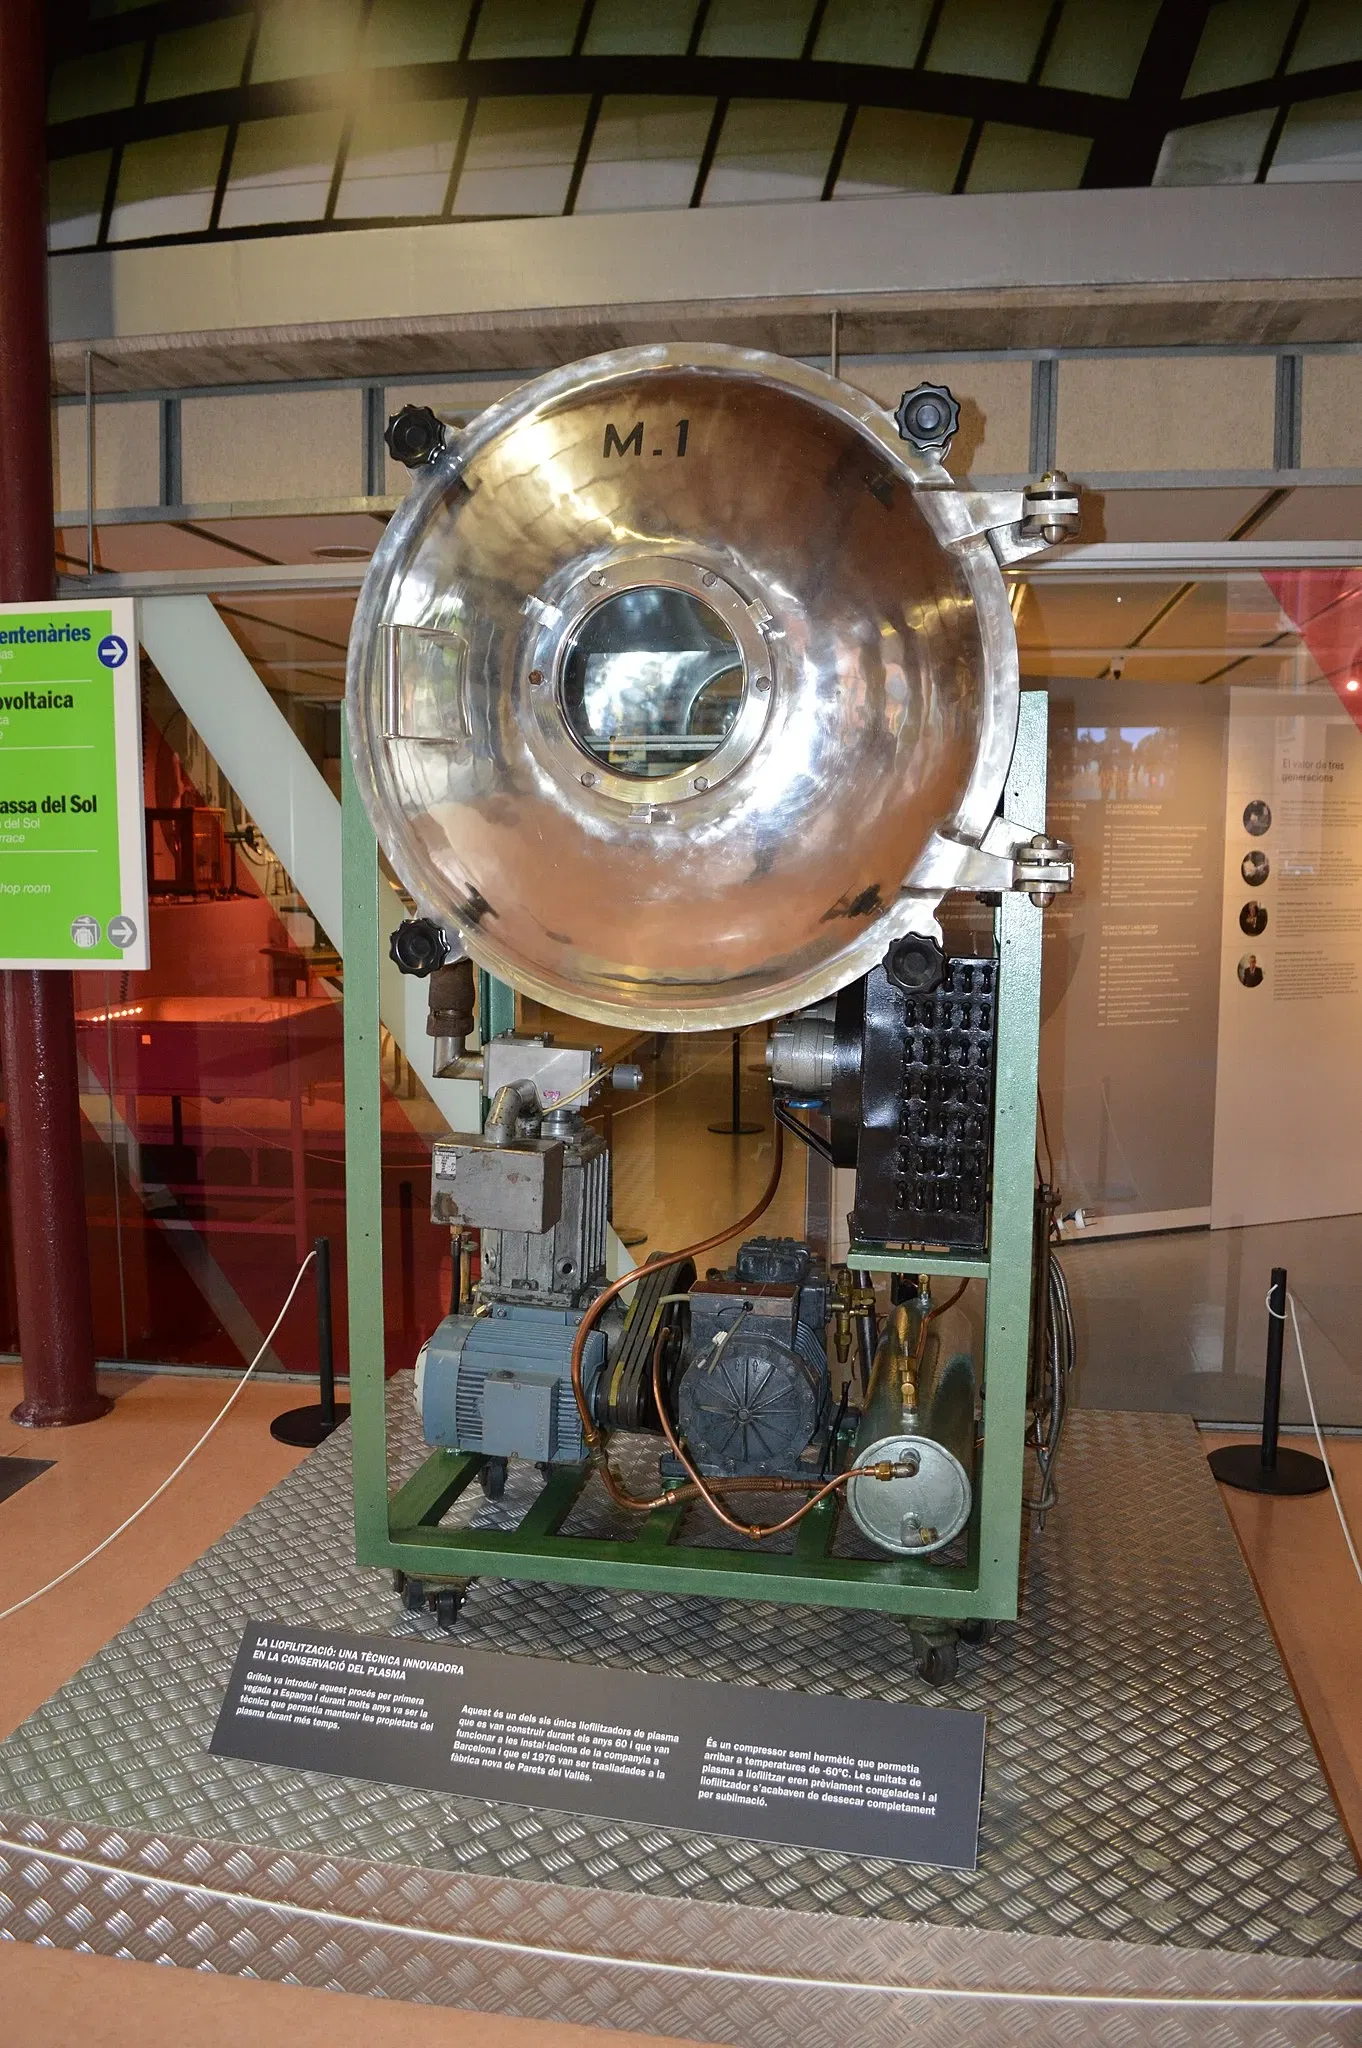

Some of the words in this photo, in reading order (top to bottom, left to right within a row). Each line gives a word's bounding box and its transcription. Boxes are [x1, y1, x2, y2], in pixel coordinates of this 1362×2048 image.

[0, 622, 91, 644] entenàries
[1328, 762, 1344, 770] tres
[0, 800, 36, 814] assa
[41, 796, 66, 813] del
[70, 794, 96, 813] Sol
[4, 818, 20, 828] del
[23, 818, 40, 828] Sol
[23, 884, 50, 893] room
[253, 1650, 266, 1660] EN
[268, 1652, 278, 1661] LA
[281, 1654, 345, 1672] CONSERVACIÓ
[347, 1664, 365, 1674] DEL
[367, 1666, 406, 1680] PLASMA
[256, 1637, 268, 1647] LA
[270, 1639, 336, 1656] LIOFILITZACIÓ:
[339, 1649, 358, 1660] UNA
[360, 1651, 400, 1666] TÈCNICA
[403, 1658, 464, 1675] INNOVADORA
[244, 1684, 271, 1695] vegada
[280, 1688, 313, 1702] Espanya
[319, 1694, 345, 1706] durant
[347, 1700, 370, 1710] molts
[372, 1703, 390, 1713] anys
[393, 1706, 403, 1714] va
[405, 1708, 418, 1717] ser
[420, 1708, 428, 1718] la
[285, 1676, 318, 1690] introduir
[320, 1684, 347, 1696] aquest
[348, 1687, 376, 1698] procés
[377, 1692, 391, 1700] per
[393, 1694, 424, 1705] primera
[236, 1706, 265, 1718] plasma
[266, 1710, 293, 1722] durant
[294, 1716, 310, 1725] més
[313, 1718, 340, 1730] temps.
[240, 1694, 269, 1706] tècnica
[271, 1699, 285, 1709] que
[287, 1701, 323, 1714] permetia
[324, 1706, 361, 1720] mantenir
[362, 1713, 374, 1722] les
[376, 1716, 418, 1729] propietats
[420, 1722, 434, 1731] del
[461, 1704, 492, 1716] Aquest
[494, 1709, 503, 1719] és
[506, 1712, 517, 1720] un
[518, 1712, 536, 1723] dels
[539, 1715, 551, 1725] sis
[553, 1717, 577, 1729] únics
[579, 1721, 631, 1737] liofilitzadors
[634, 1728, 644, 1738] de
[647, 1731, 680, 1742] plasma
[456, 1729, 496, 1742] funcionar
[505, 1736, 518, 1746] les
[520, 1737, 577, 1754] instal·lacions
[580, 1747, 591, 1756] de
[593, 1748, 602, 1757] la
[604, 1750, 651, 1764] companyia
[653, 1757, 659, 1766] a
[459, 1718, 474, 1727] que
[490, 1722, 504, 1731] van
[506, 1725, 545, 1737] construir
[547, 1729, 575, 1741] durant
[577, 1734, 590, 1743] els
[592, 1736, 612, 1747] anys
[615, 1739, 627, 1748] 60
[635, 1743, 651, 1752] que
[654, 1746, 670, 1754] van
[451, 1753, 480, 1765] fàbrica
[482, 1758, 502, 1768] nova
[504, 1761, 515, 1770] de
[518, 1763, 546, 1775] Parets
[548, 1767, 561, 1777] del
[564, 1768, 592, 1782] Vallès.
[454, 1740, 496, 1755] Barcelona
[503, 1749, 520, 1759] que
[521, 1751, 530, 1760] el
[532, 1752, 556, 1763] 1976
[558, 1757, 573, 1766] van
[576, 1760, 589, 1768] ser
[592, 1761, 646, 1776] traslladades
[648, 1770, 654, 1778] a
[657, 1769, 665, 1779] la
[704, 1752, 734, 1763] arribar
[745, 1756, 806, 1772] temperatures
[808, 1765, 820, 1774] de
[854, 1770, 871, 1781] Les
[873, 1773, 906, 1785] unitats
[910, 1778, 921, 1787] de
[706, 1736, 717, 1748] És
[734, 1743, 787, 1757] compressor
[789, 1751, 811, 1761] semi
[814, 1752, 855, 1766] hermètic
[858, 1759, 875, 1768] que
[877, 1761, 920, 1774] permetia
[698, 1790, 713, 1799] per
[715, 1791, 768, 1807] sublimació.
[700, 1776, 751, 1791] liofilitzador
[807, 1791, 819, 1800] de
[822, 1793, 865, 1806] dessecar
[867, 1799, 936, 1815] completament
[702, 1764, 735, 1776] plasma
[746, 1769, 785, 1782] liofilitzar
[788, 1776, 808, 1786] eren
[811, 1778, 863, 1793] prèviament
[866, 1786, 920, 1800] congelades
[928, 1793, 937, 1802] al
